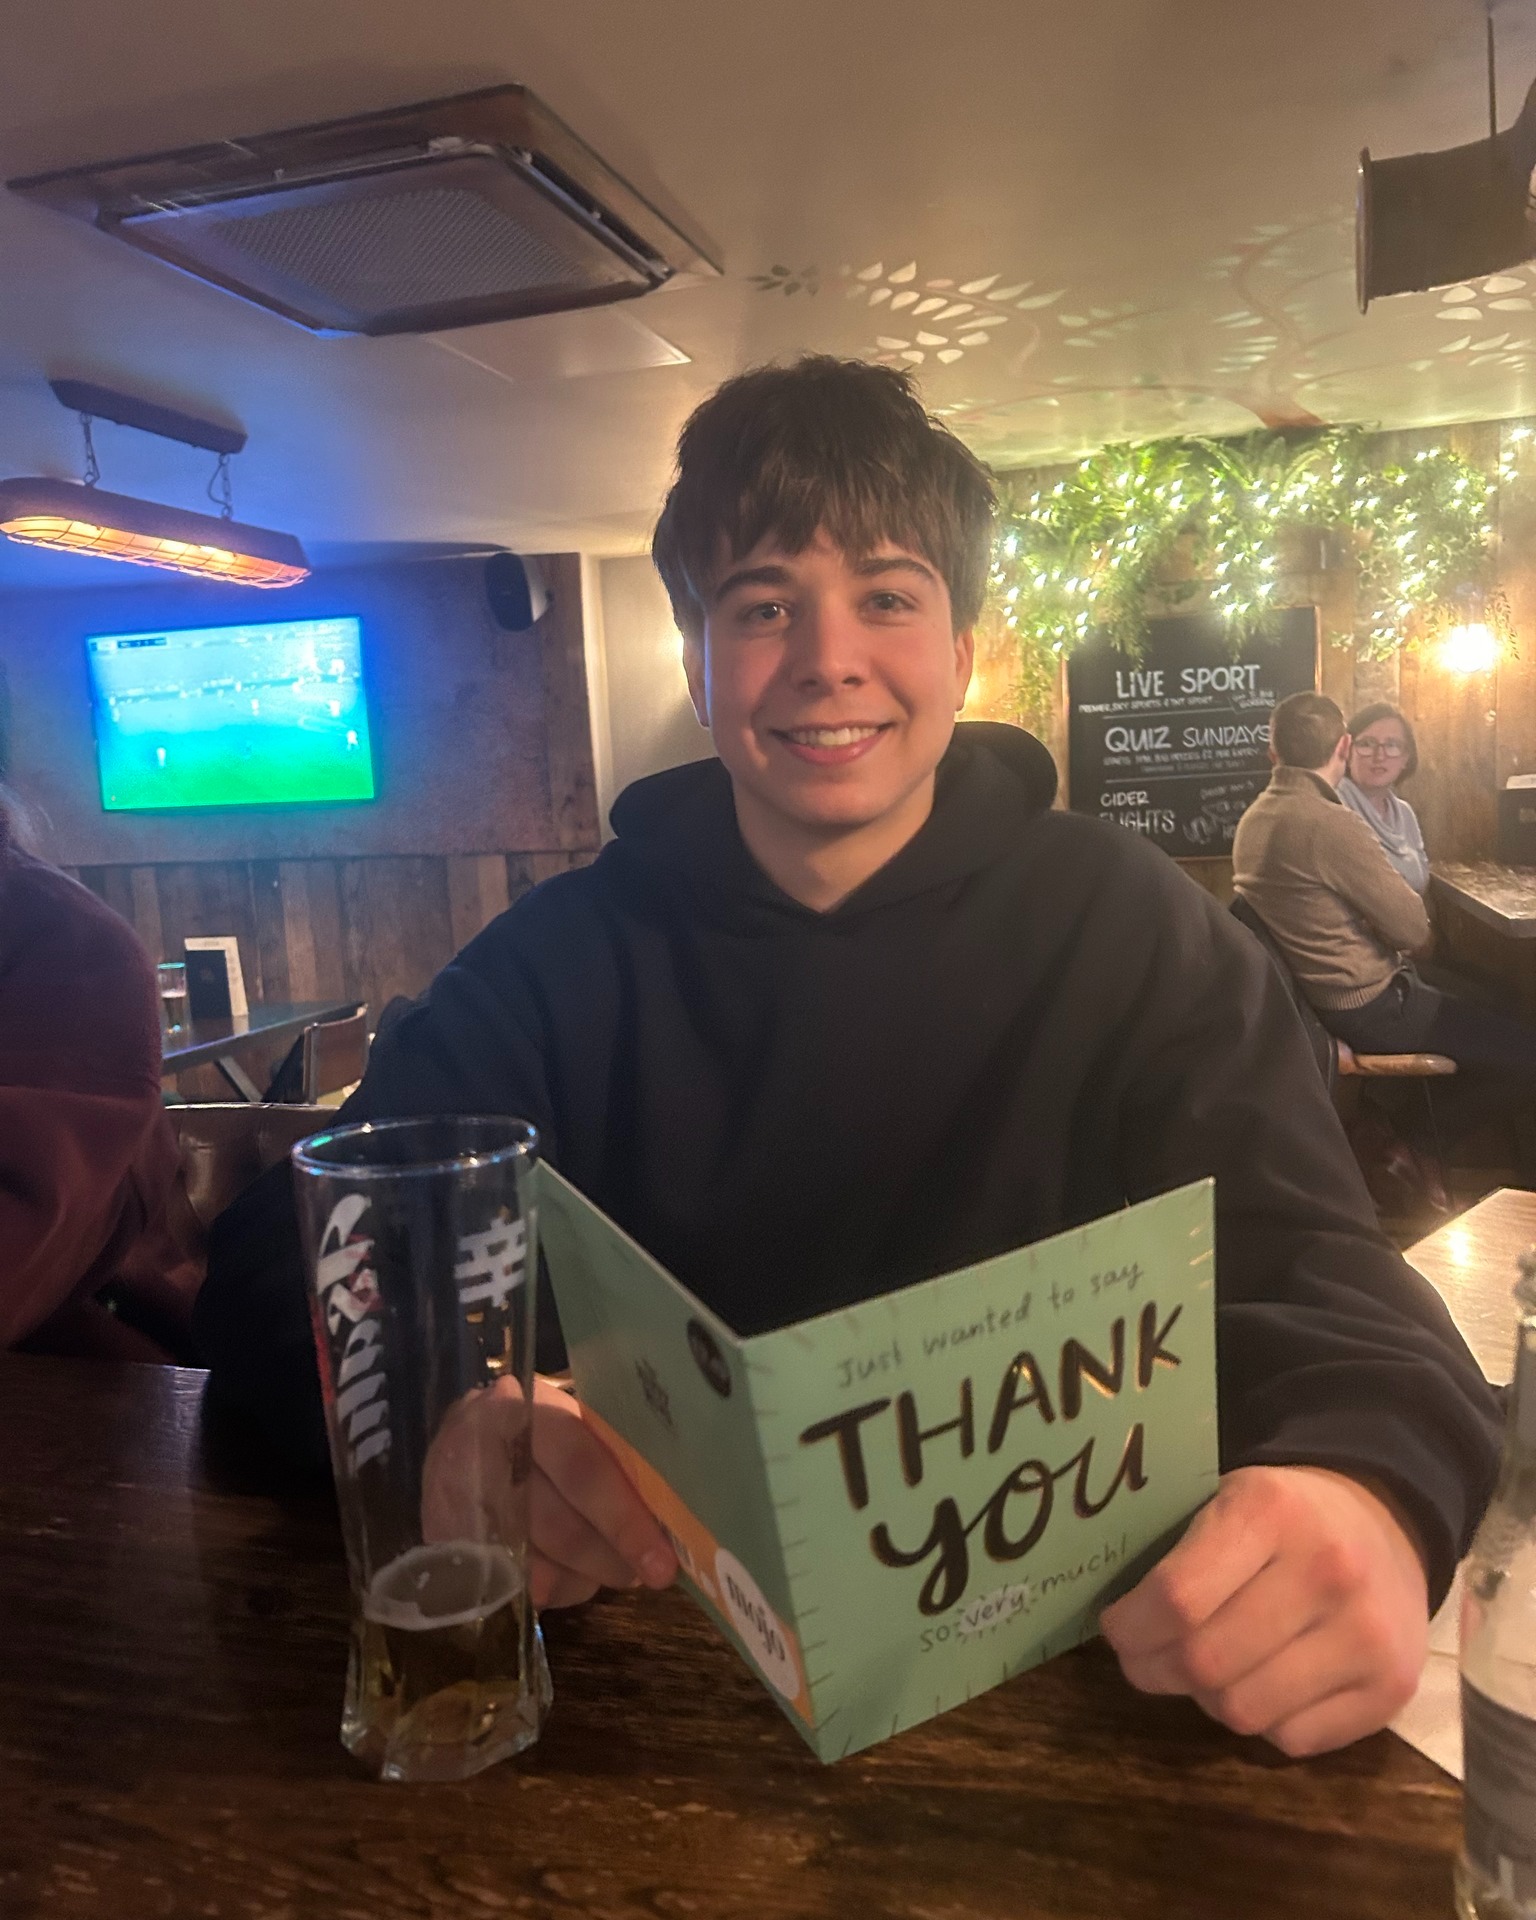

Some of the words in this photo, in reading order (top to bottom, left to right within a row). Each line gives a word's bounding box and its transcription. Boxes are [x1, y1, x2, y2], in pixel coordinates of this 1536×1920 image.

[1115, 671, 1164, 699] LIVE
[1180, 664, 1261, 693] SPORT
[1105, 726, 1172, 753] QUIZ
[1182, 724, 1273, 748] SUNDAYS
[1100, 790, 1150, 807] CIDER
[923, 1292, 1032, 1356] wanted
[1049, 1281, 1075, 1311] to
[1091, 1260, 1144, 1298] say
[800, 1301, 1183, 1511] THANK
[919, 1624, 951, 1653] so
[965, 1590, 1027, 1630] very
[1041, 1534, 1127, 1594] much!
